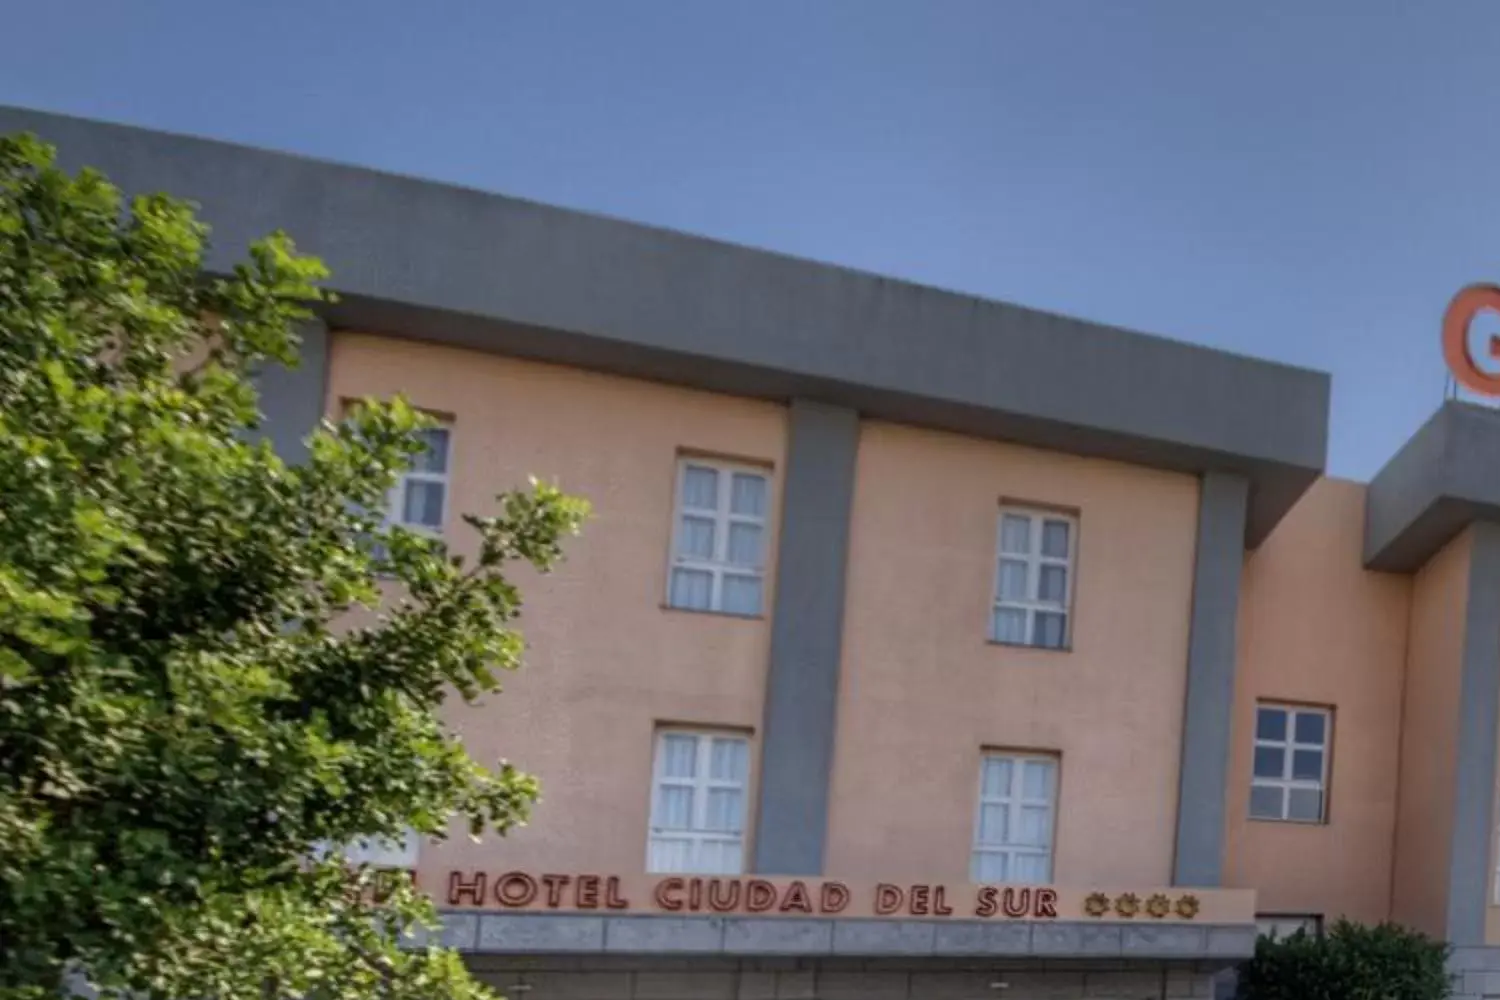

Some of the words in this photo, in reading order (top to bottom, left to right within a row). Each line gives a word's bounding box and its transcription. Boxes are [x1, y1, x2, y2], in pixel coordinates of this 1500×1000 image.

[448, 870, 628, 909] HOTEL
[653, 876, 850, 914] CIUDAD
[875, 882, 953, 916] DEL
[975, 886, 1058, 918] SUR
